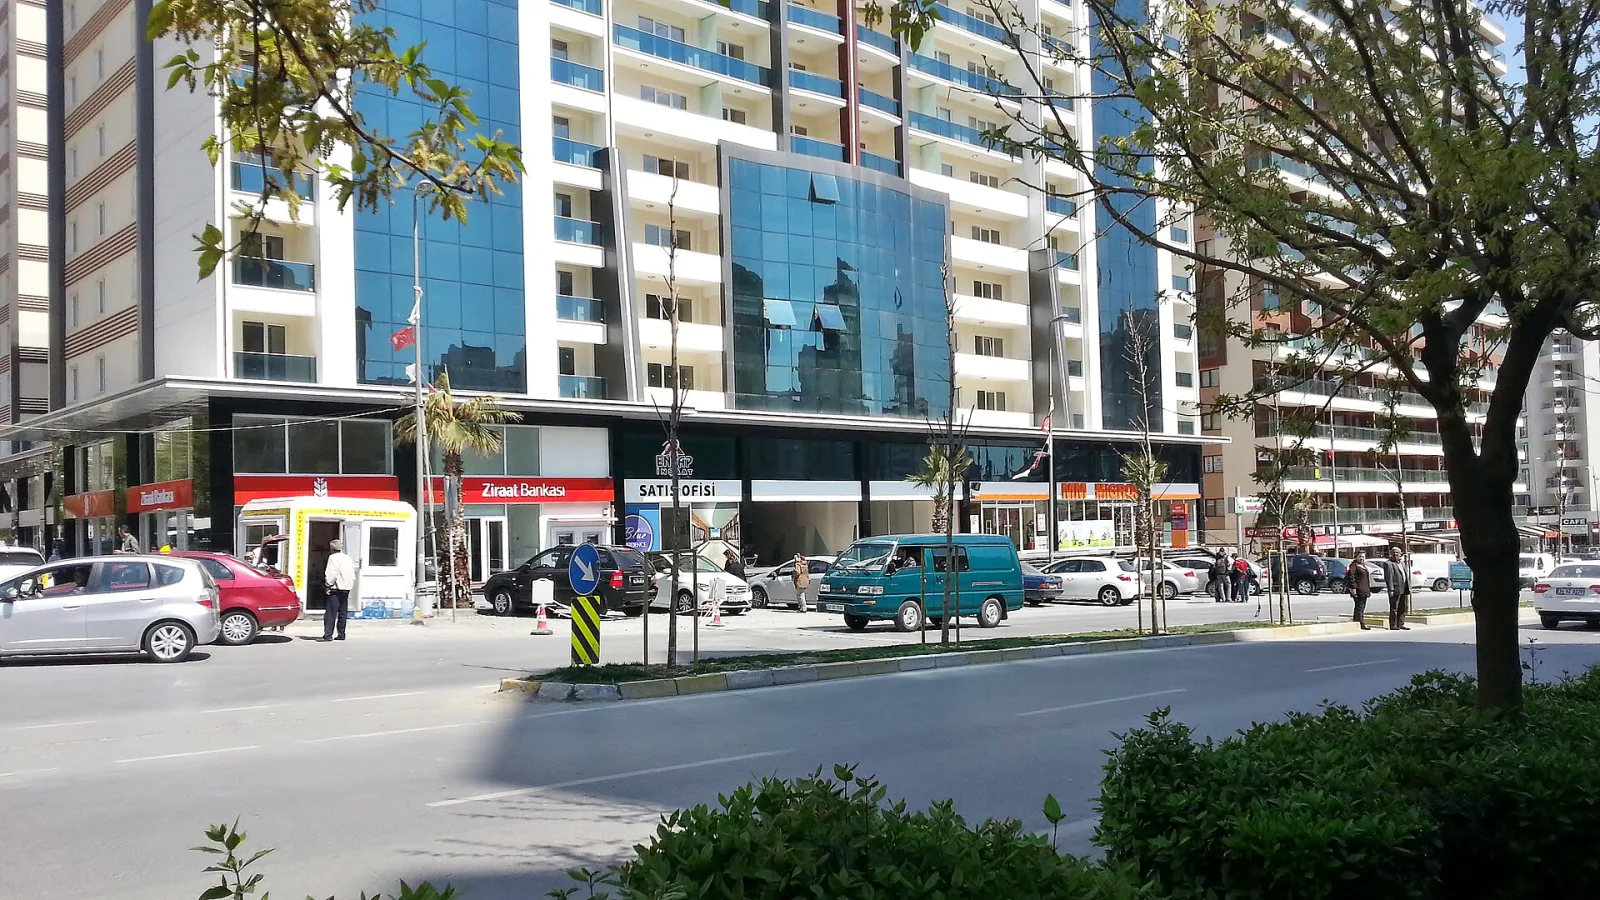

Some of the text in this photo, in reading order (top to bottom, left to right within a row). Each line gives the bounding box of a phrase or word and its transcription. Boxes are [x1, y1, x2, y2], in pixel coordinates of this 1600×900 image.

[481, 482, 566, 498] Ziraat Bankası
[681, 482, 716, 497] OFİSİ
